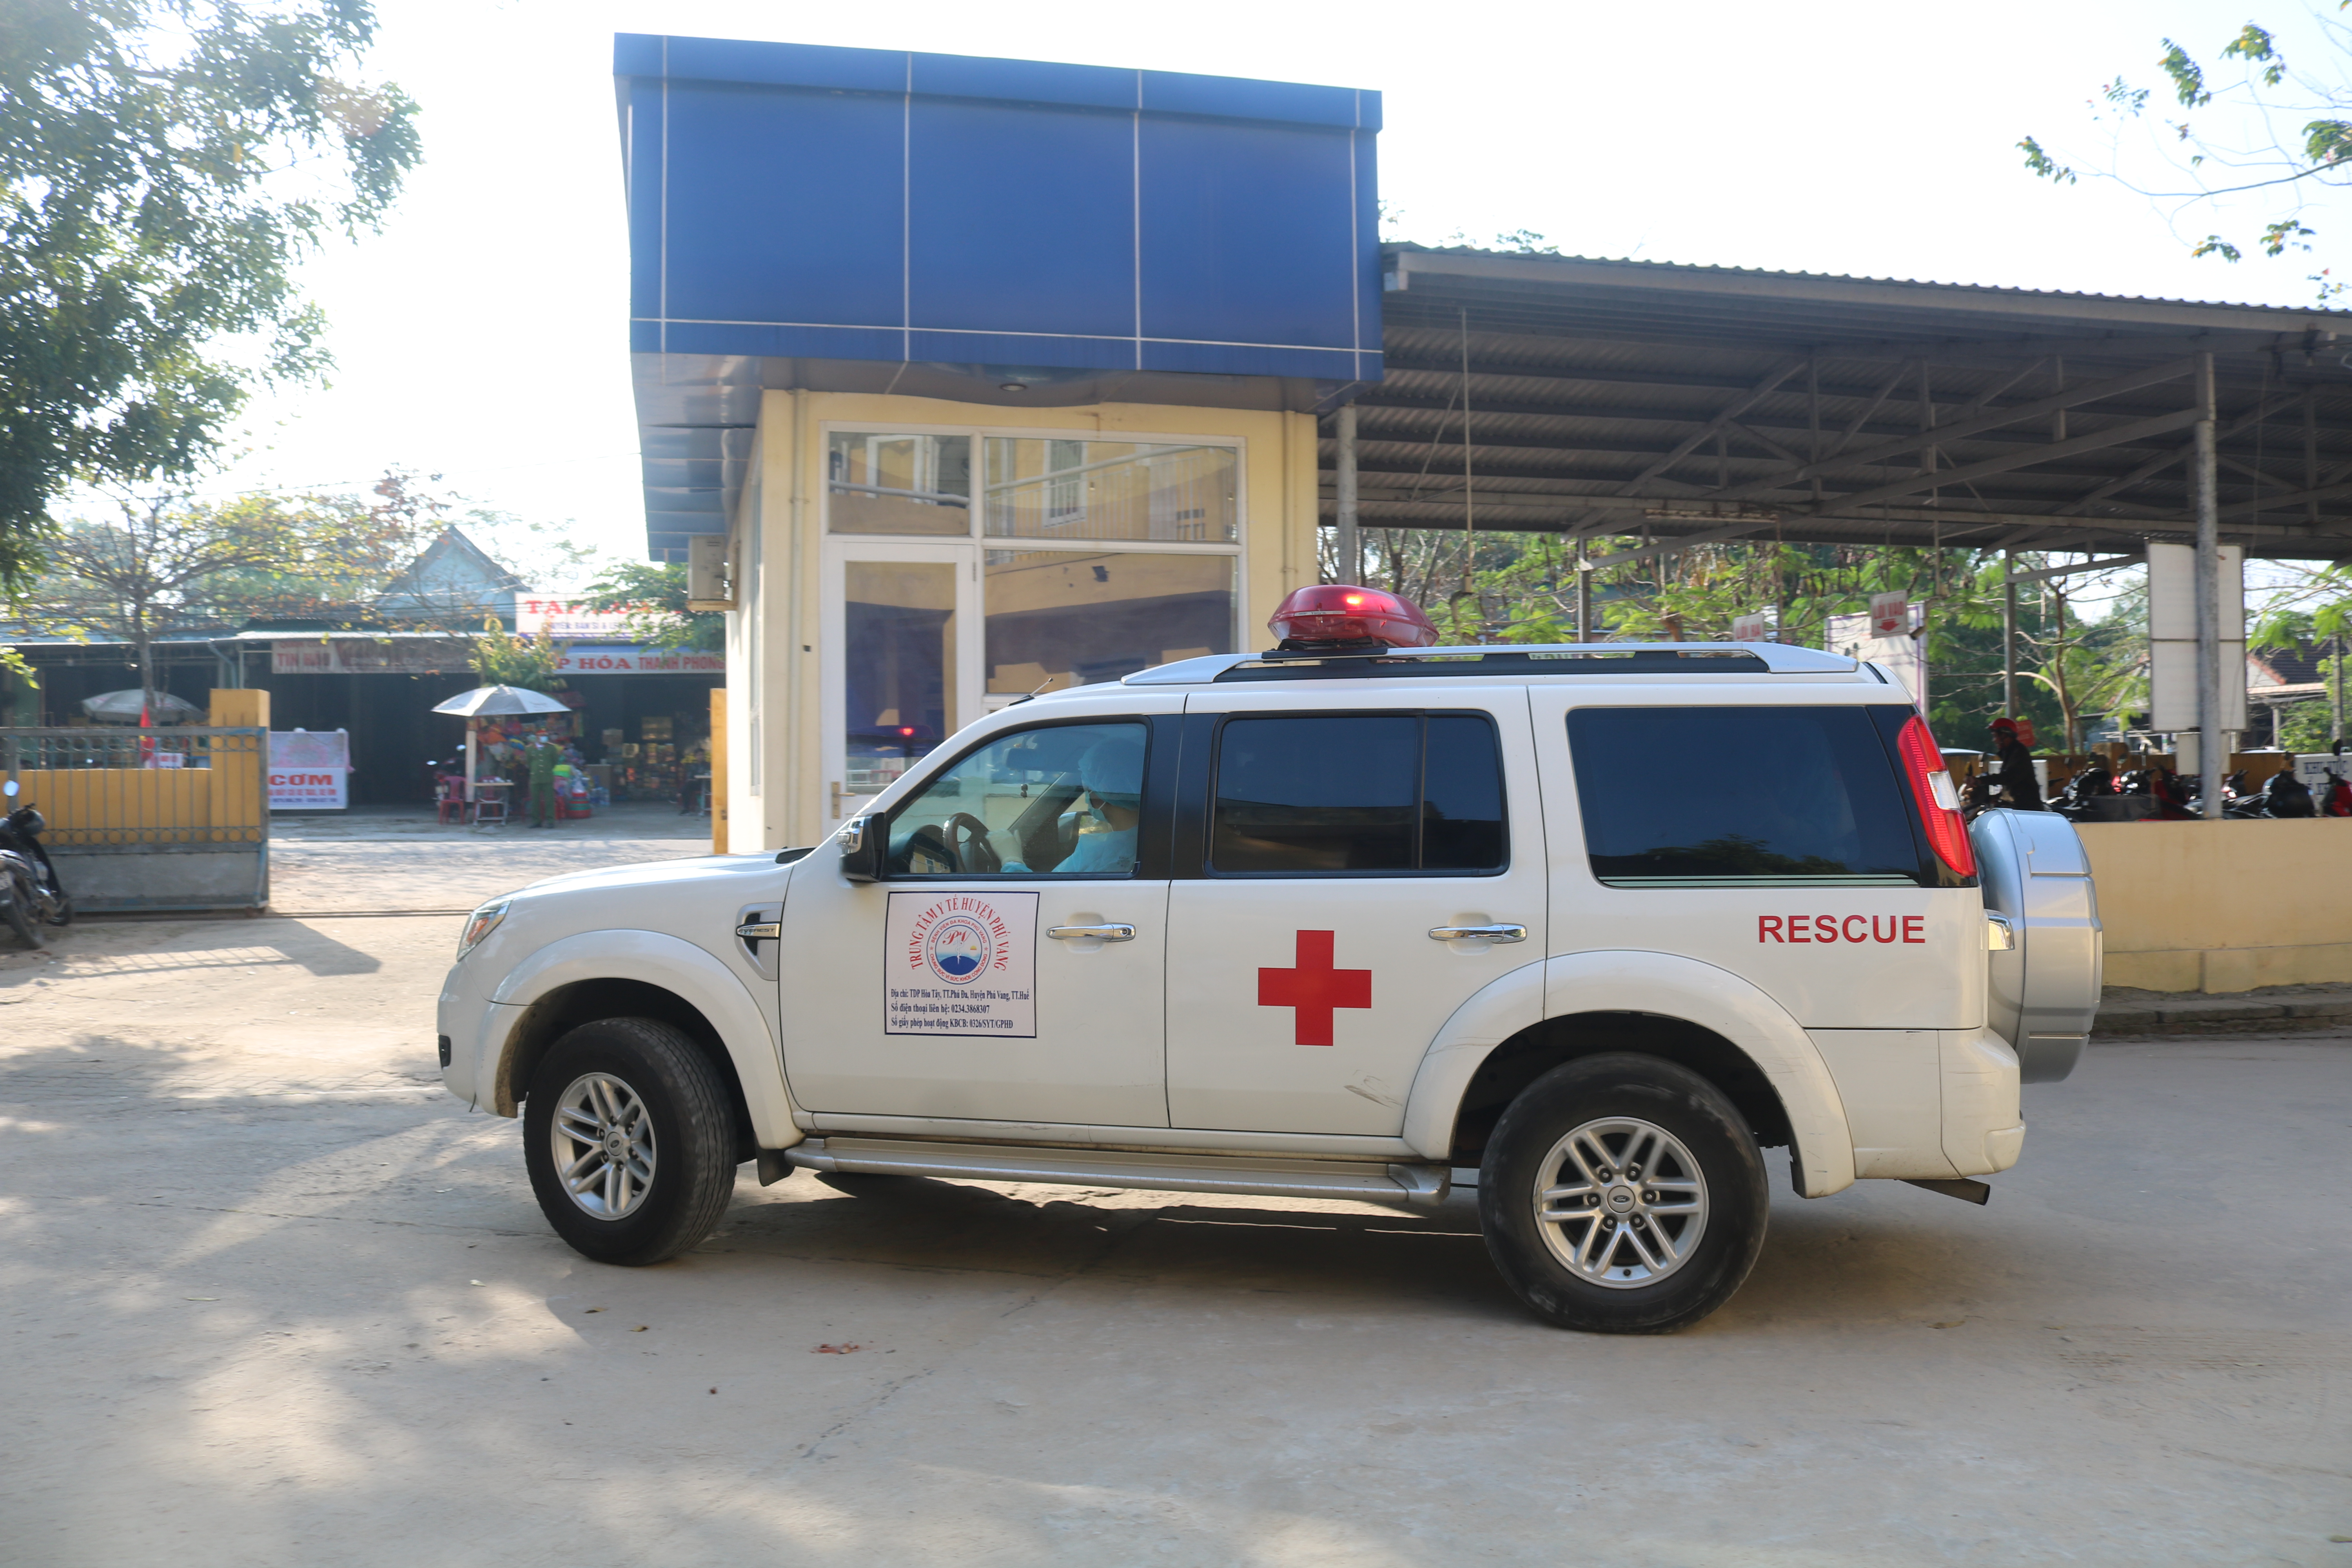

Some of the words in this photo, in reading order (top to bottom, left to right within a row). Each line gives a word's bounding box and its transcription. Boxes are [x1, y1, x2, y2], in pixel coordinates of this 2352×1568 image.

[578, 655, 632, 670] HÓA
[269, 774, 333, 786] CƠM
[936, 902, 944, 915] Y
[945, 894, 958, 912] TẾ
[960, 897, 996, 921] HUYỆN
[915, 907, 938, 931] TÂM
[989, 916, 1011, 939] PHÚ
[939, 922, 950, 931] VIỆN
[971, 923, 980, 931] PHÚ
[978, 930, 987, 944] VANG
[1759, 915, 1926, 943] RESCUE
[909, 931, 924, 970] TRUNG
[993, 941, 1009, 971] VANG
[930, 953, 938, 969] CHUNG
[891, 989, 899, 999] Địa
[909, 989, 920, 998] TDP
[921, 989, 930, 998] Hòa
[932, 989, 942, 1000] Tây,
[943, 989, 960, 998] TT.Phú
[961, 990, 969, 1000] Đa,
[970, 990, 985, 1001] Huyện
[986, 990, 996, 999] Phú
[997, 990, 1010, 1002] Vang,
[1011, 988, 1029, 1000] TT.Huế
[891, 1000, 898, 1012] Số
[900, 1003, 912, 1014] điện
[913, 1004, 927, 1014] thoại
[929, 1004, 939, 1012] liên
[941, 1004, 949, 1015] hệ:
[951, 1004, 990, 1013] 0234.3868307
[891, 1015, 898, 1026] Số
[899, 1015, 909, 1029] giấy
[910, 1017, 922, 1029] phép
[924, 1018, 935, 1029] hoạt
[936, 1018, 949, 1029] động
[950, 1018, 968, 1028] KBCB:
